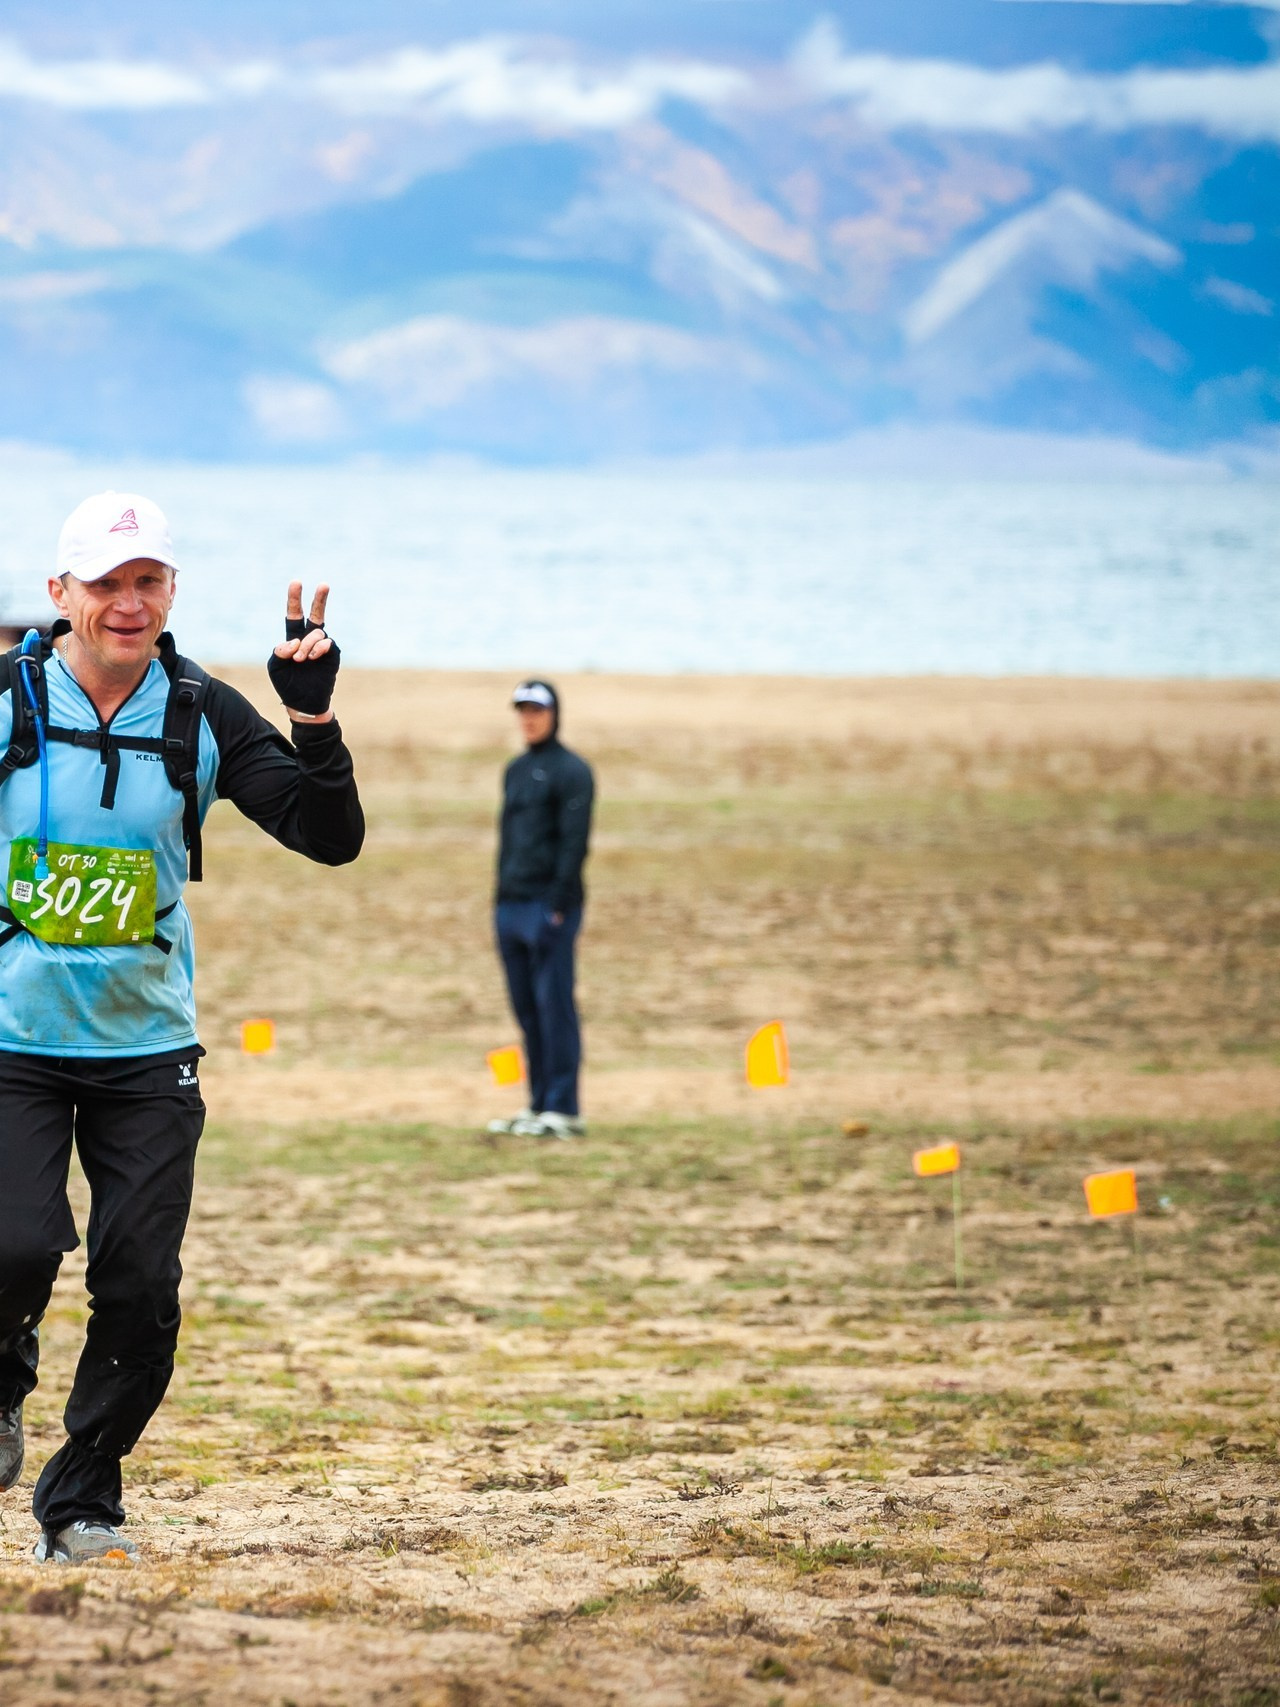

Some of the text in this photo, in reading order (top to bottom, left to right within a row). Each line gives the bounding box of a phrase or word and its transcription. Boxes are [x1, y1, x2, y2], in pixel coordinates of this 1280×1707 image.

[136, 754, 163, 762] KELM
[58, 854, 81, 871] OT
[81, 855, 97, 870] 30
[30, 872, 137, 930] 3024
